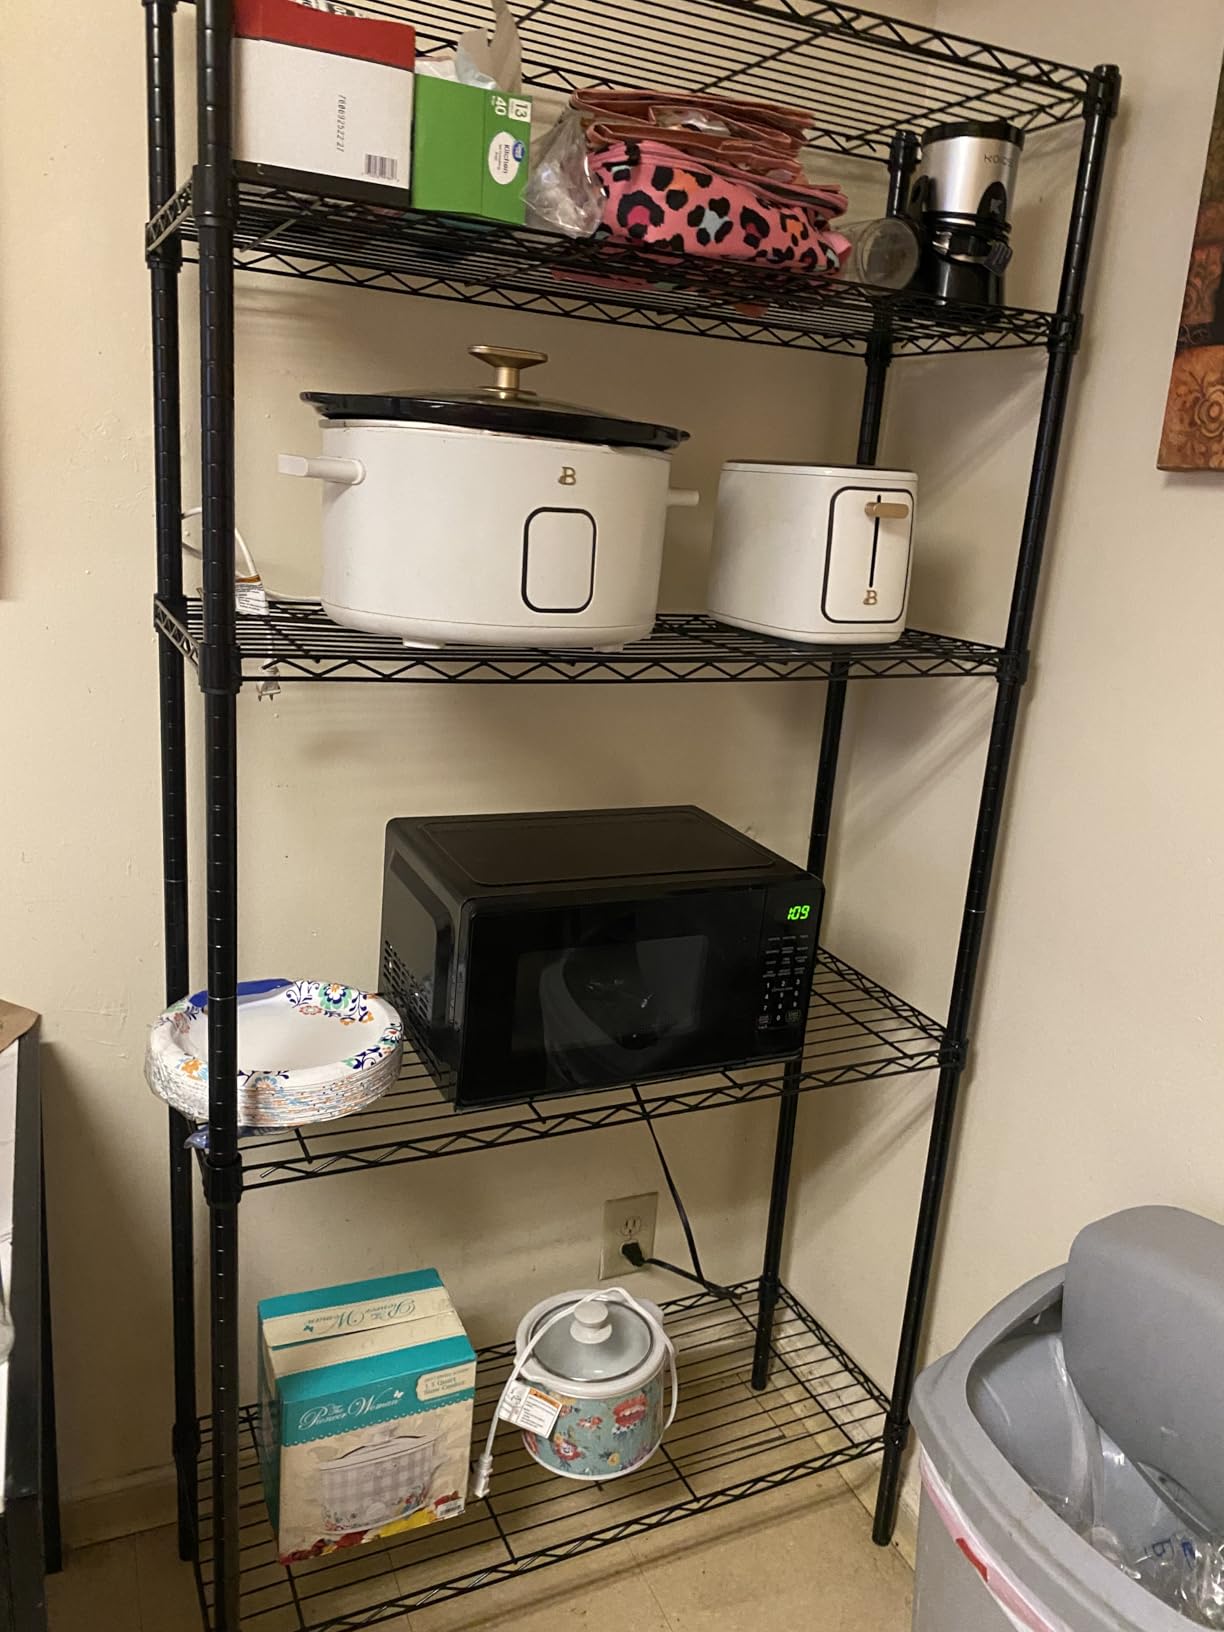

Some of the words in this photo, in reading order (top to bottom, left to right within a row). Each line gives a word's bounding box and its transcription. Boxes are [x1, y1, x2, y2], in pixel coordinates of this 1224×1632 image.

[495, 96, 507, 116] 40
[514, 103, 528, 118] 13
[298, 1406, 347, 1430] Pioneer
[348, 1387, 399, 1417] Woman
